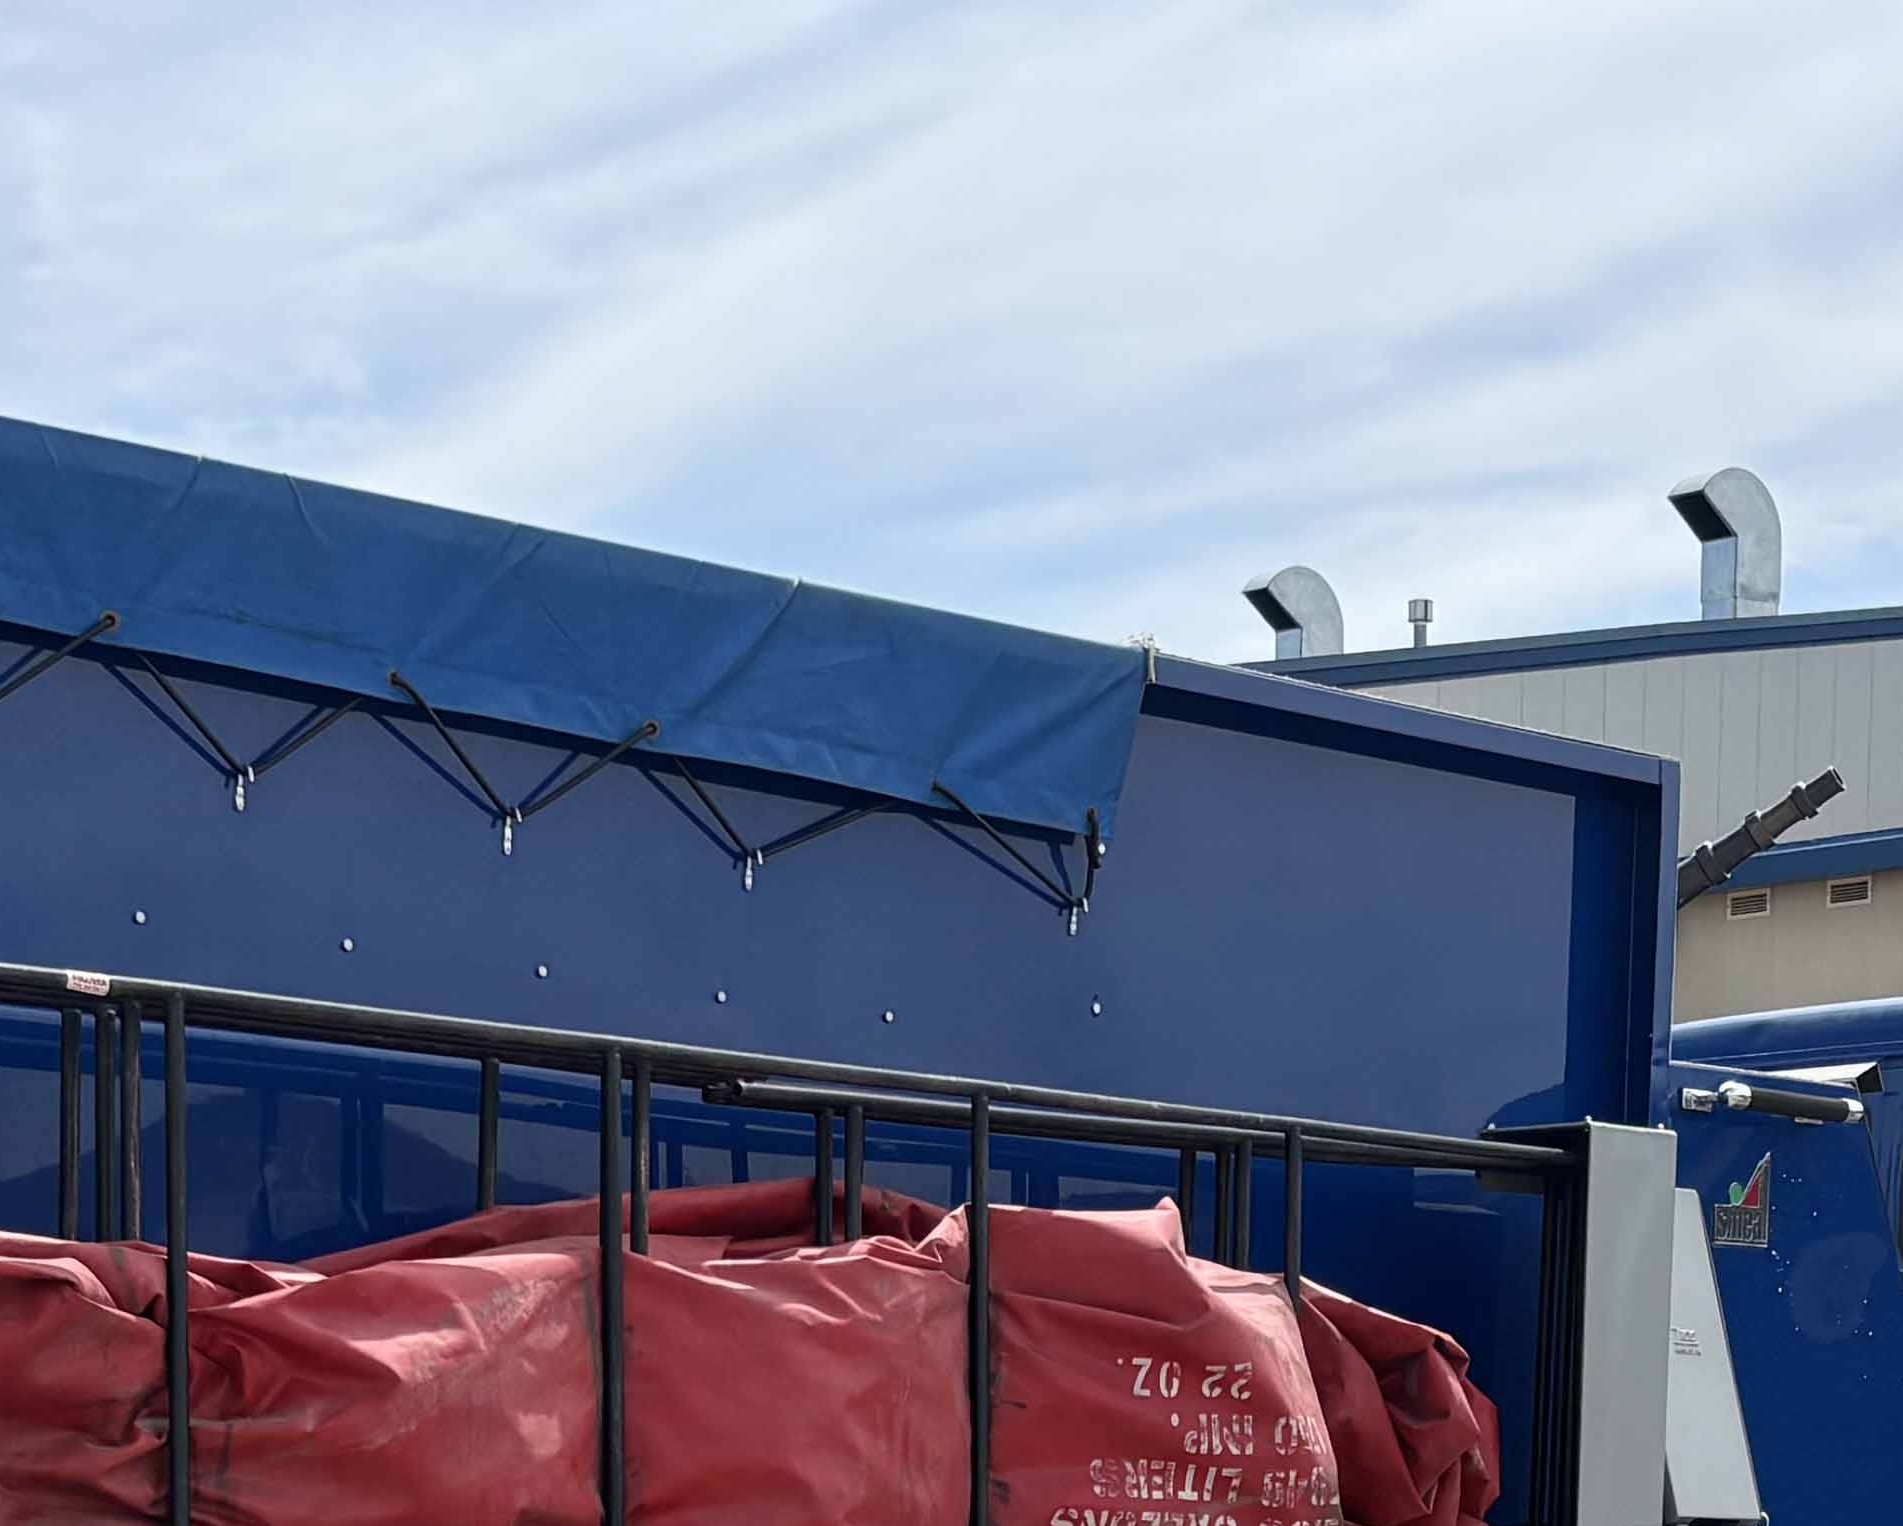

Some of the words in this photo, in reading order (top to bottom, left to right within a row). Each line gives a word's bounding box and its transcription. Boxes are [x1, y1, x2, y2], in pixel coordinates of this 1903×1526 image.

[1116, 1357, 1182, 1399] OZ.
[1201, 1361, 1254, 1400] 22
[1170, 1412, 1254, 1456] IMP.
[1090, 1458, 1243, 1504] LITERS
